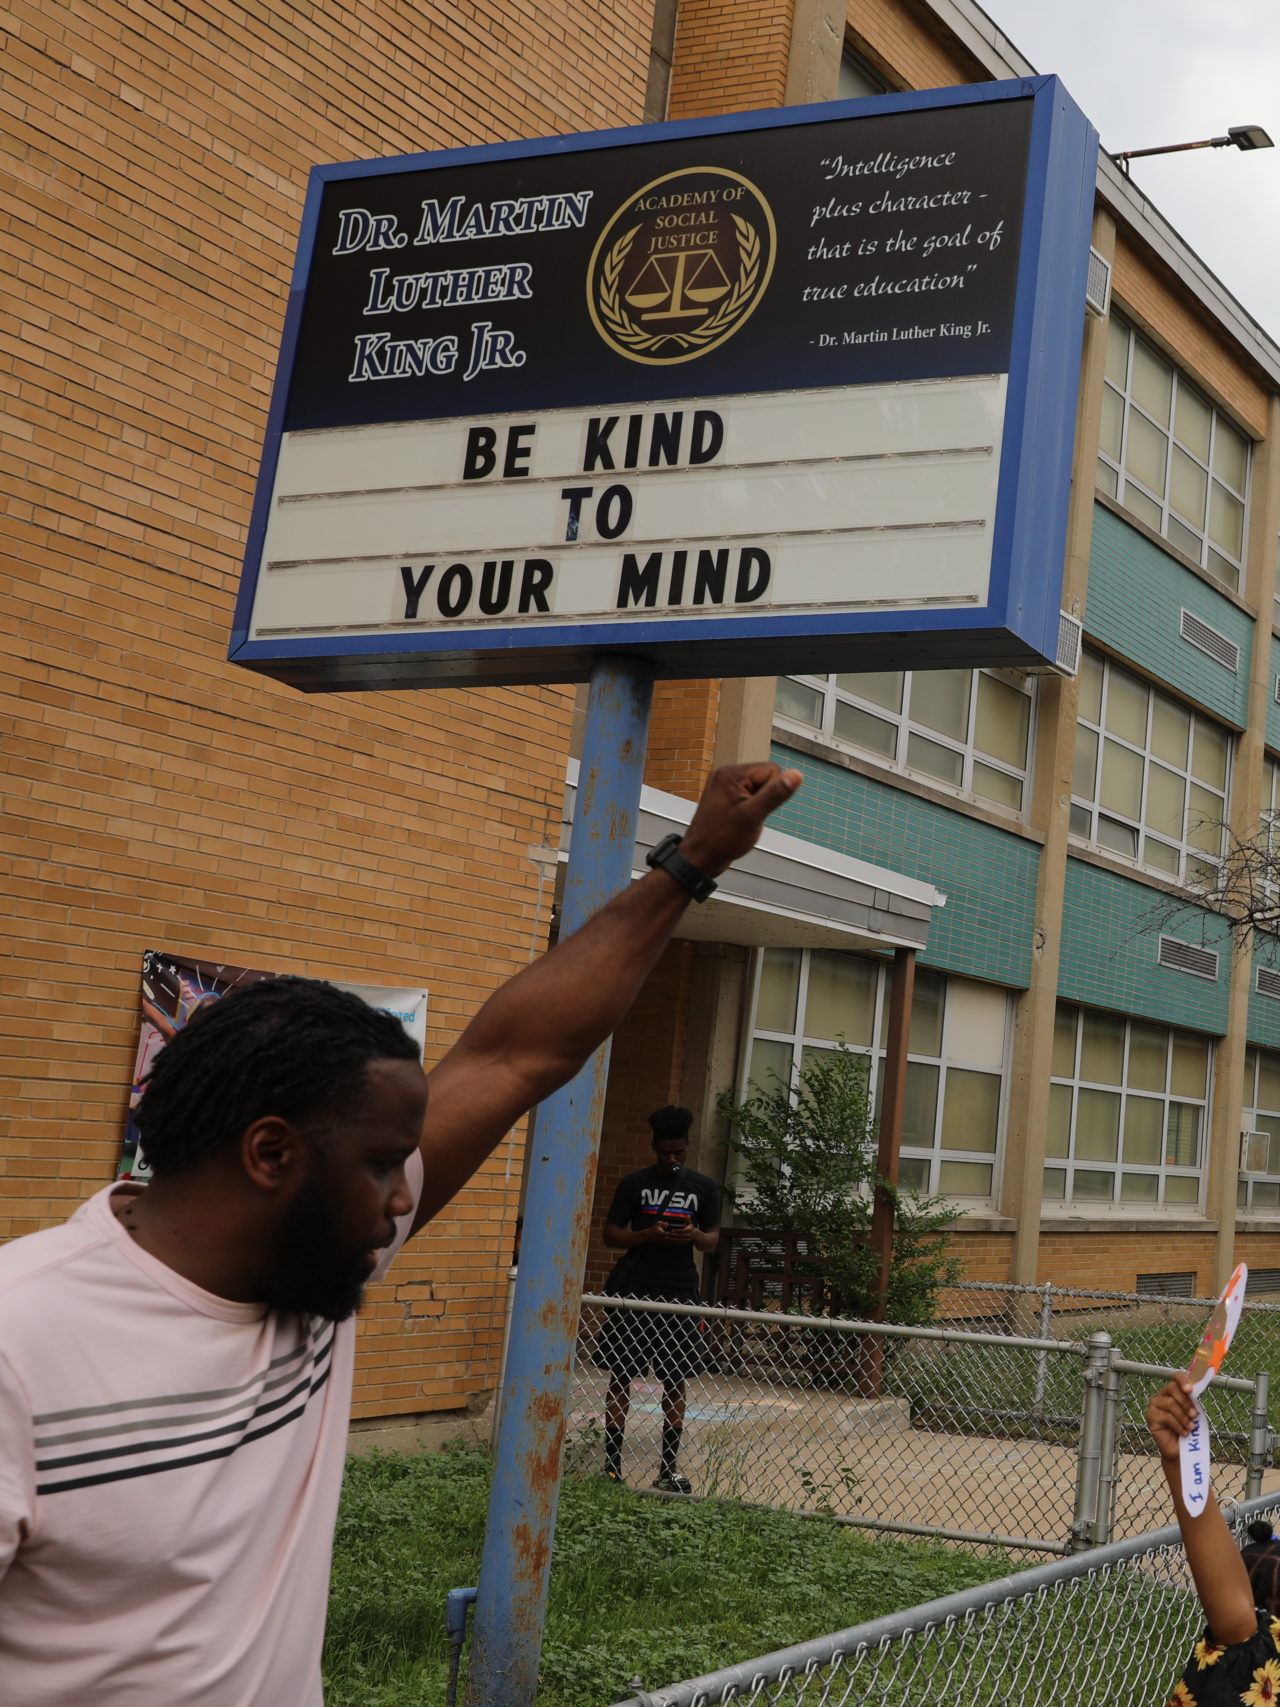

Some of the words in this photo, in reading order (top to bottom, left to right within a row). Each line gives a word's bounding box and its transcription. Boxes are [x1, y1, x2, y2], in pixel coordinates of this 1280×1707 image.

[634, 189, 720, 212] ACADEMY
[723, 186, 746, 202] OF
[810, 197, 863, 228] plus
[868, 190, 972, 214] character
[655, 210, 719, 230] SOCIAL
[648, 230, 719, 254] JUSTICE
[807, 237, 852, 260] that
[857, 238, 879, 256] is
[885, 229, 918, 252] the
[922, 223, 972, 258] goal
[977, 220, 1004, 251] of
[802, 283, 848, 301] true
[818, 333, 839, 347] Dr.
[842, 329, 888, 346] Martin
[891, 325, 936, 341] Luther
[939, 322, 972, 339] King
[976, 320, 992, 336] Jr.
[462, 423, 536, 480] BE
[582, 409, 725, 472] KIND
[560, 483, 634, 542] TO
[399, 558, 555, 619] YOUR
[616, 546, 772, 609] MIND
[640, 1188, 698, 1211] NASA
[1193, 1462, 1203, 1485] am
[1189, 1492, 1204, 1502] I
